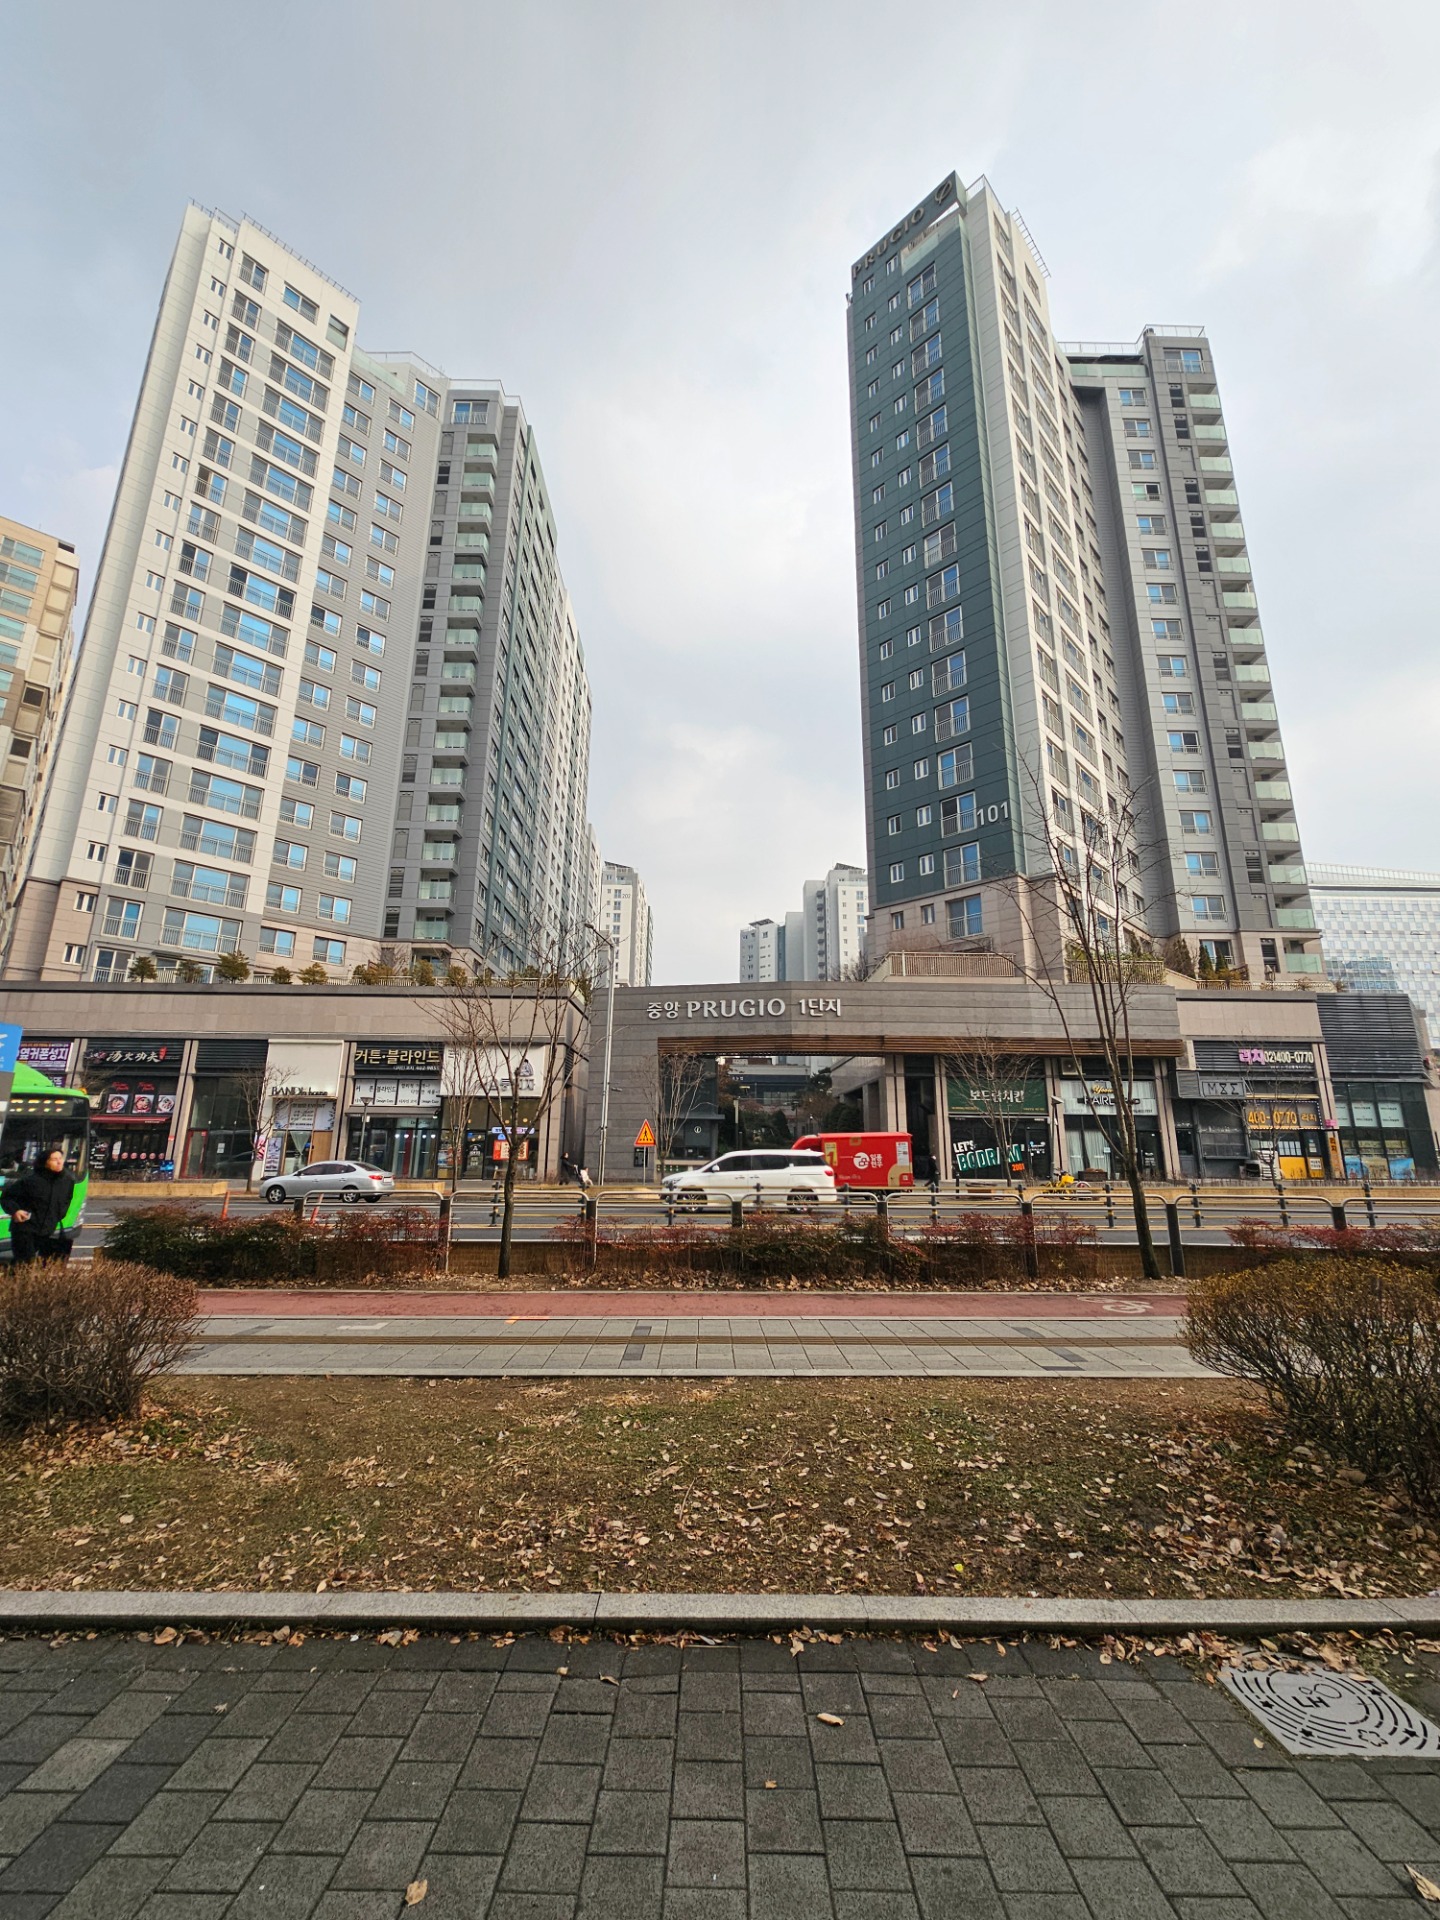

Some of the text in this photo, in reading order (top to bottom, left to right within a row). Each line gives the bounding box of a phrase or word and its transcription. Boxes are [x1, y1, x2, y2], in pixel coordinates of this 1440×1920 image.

[851, 207, 925, 279] PRUGIO
[976, 801, 1009, 826] 101
[647, 998, 842, 1019] 중앙 PRUGIO 1단지
[1291, 1696, 1330, 1708] LH
